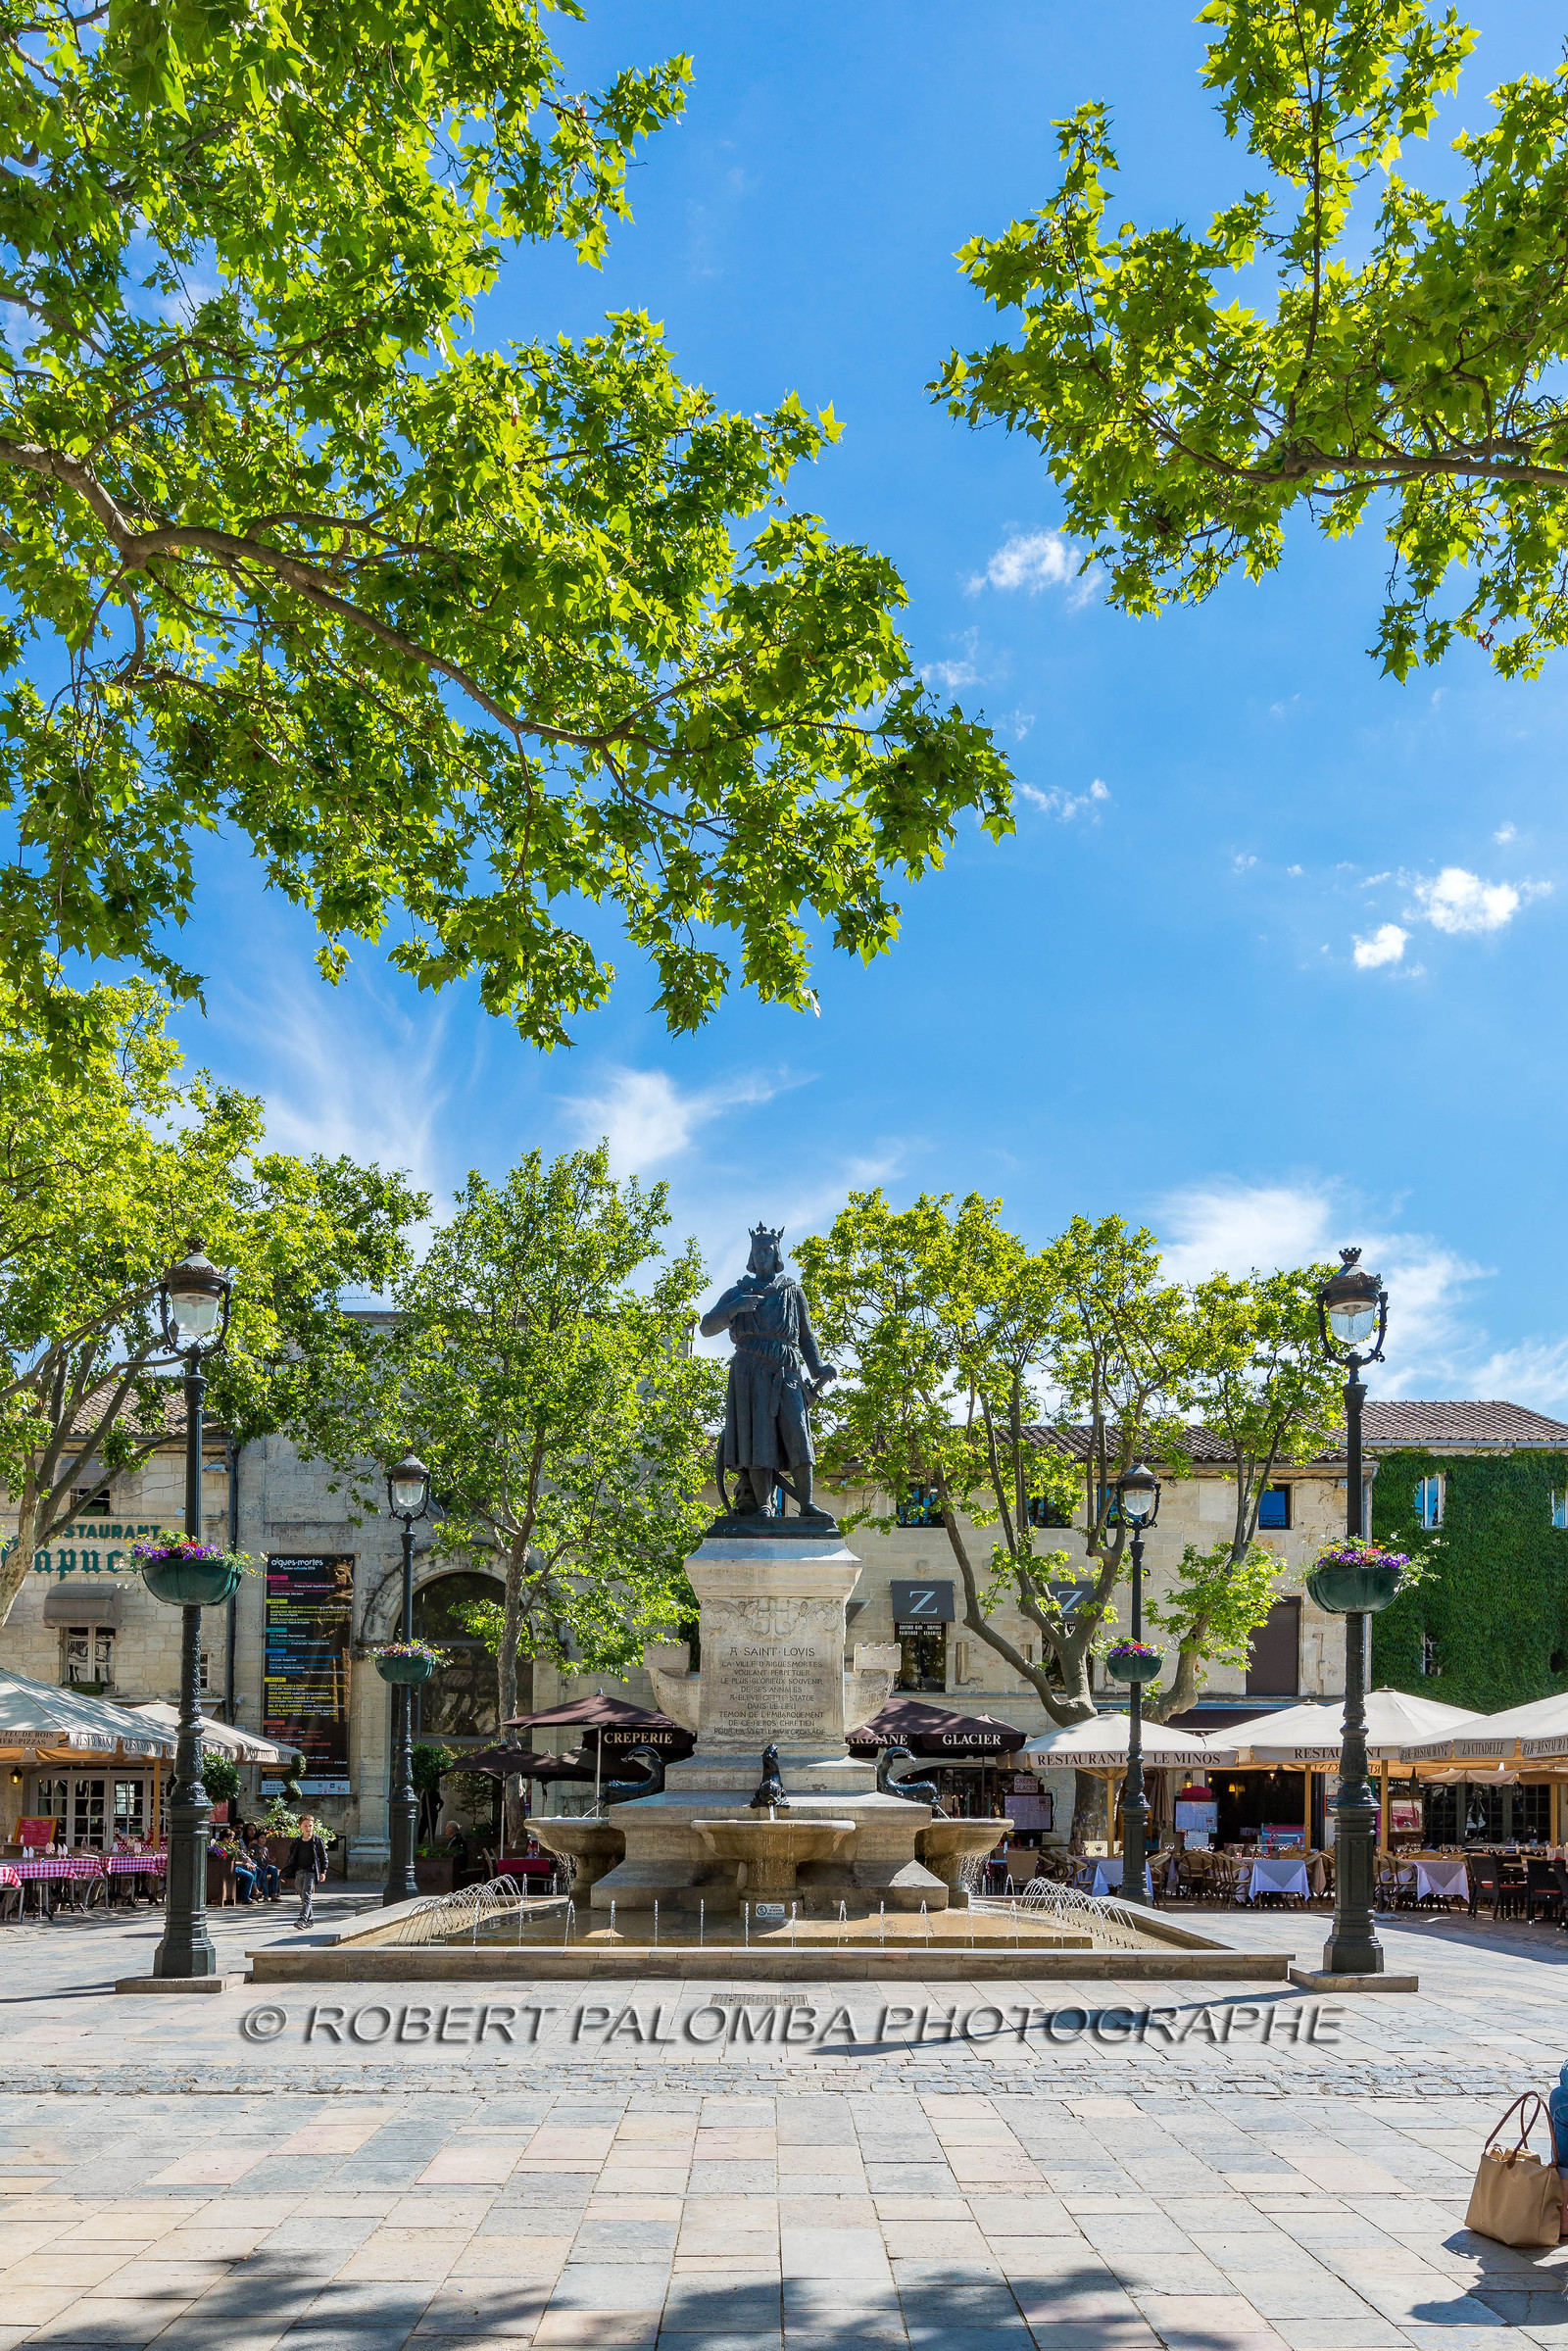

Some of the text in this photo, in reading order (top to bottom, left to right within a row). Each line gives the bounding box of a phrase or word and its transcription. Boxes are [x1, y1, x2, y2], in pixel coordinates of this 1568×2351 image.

[60, 1524, 162, 1540] STAURANT
[909, 1591, 938, 1614] Z
[1057, 1591, 1083, 1614] Z
[744, 1646, 777, 1656] SAINT
[604, 1732, 673, 1743] CREPERIE
[942, 1734, 1002, 1745] GLACIER
[1037, 1752, 1126, 1766] RESTAURANT
[1153, 1752, 1221, 1765] LE MINOS
[1295, 1747, 1383, 1759] RESTAUNT
